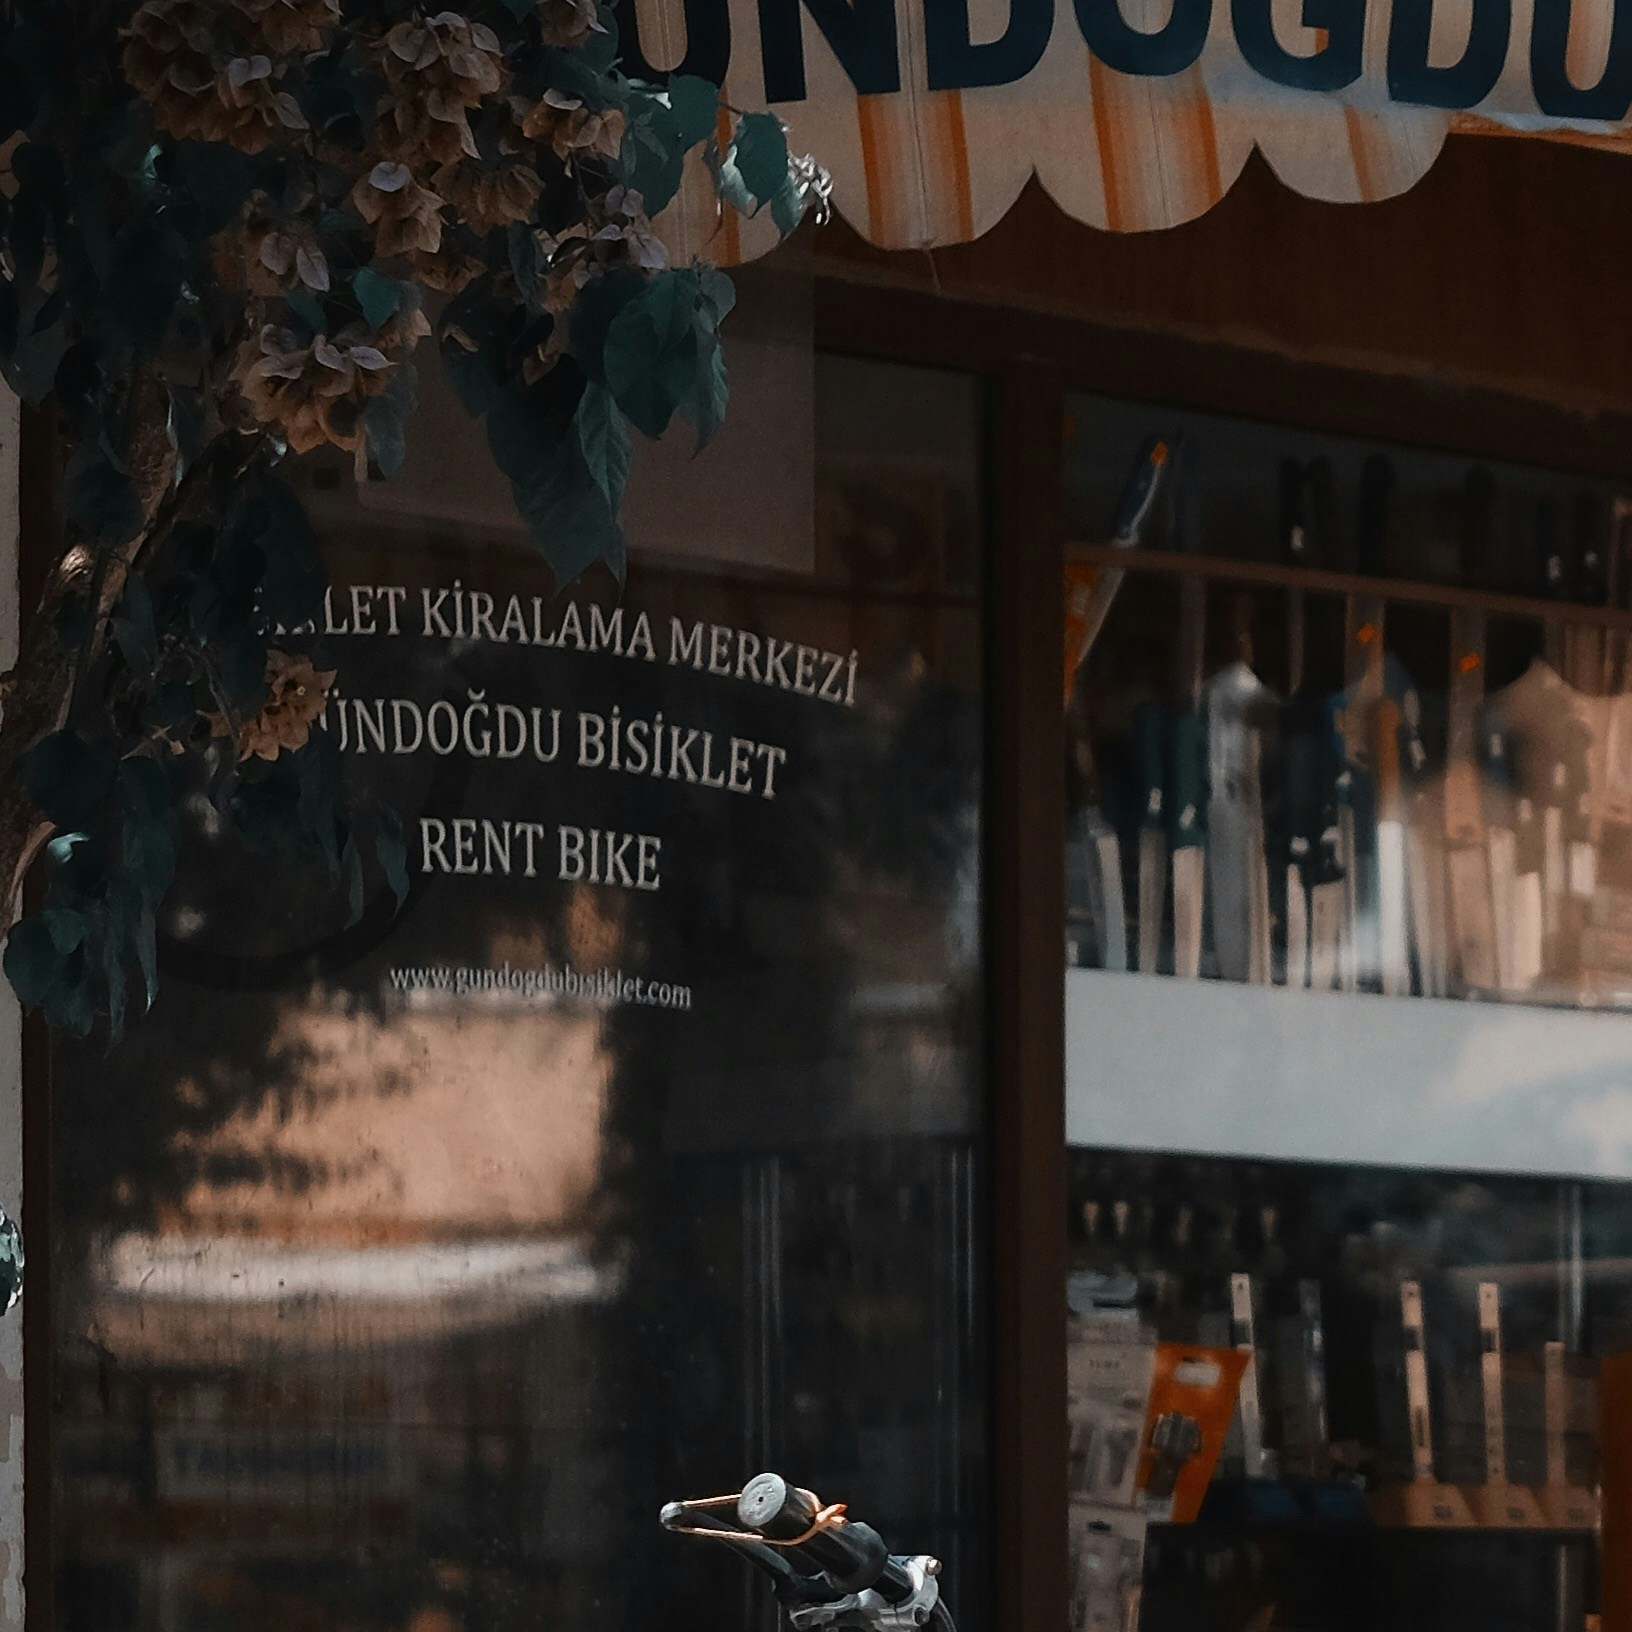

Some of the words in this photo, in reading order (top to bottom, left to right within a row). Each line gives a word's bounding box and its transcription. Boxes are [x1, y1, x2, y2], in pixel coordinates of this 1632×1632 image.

[421, 580, 656, 661] KİRALAMA
[669, 617, 860, 707] MERKEZİ
[318, 687, 563, 763] ÜNDOĞDU
[577, 704, 787, 800] BİSİKLET
[420, 816, 545, 877] RENT
[558, 824, 663, 891] BIKE
